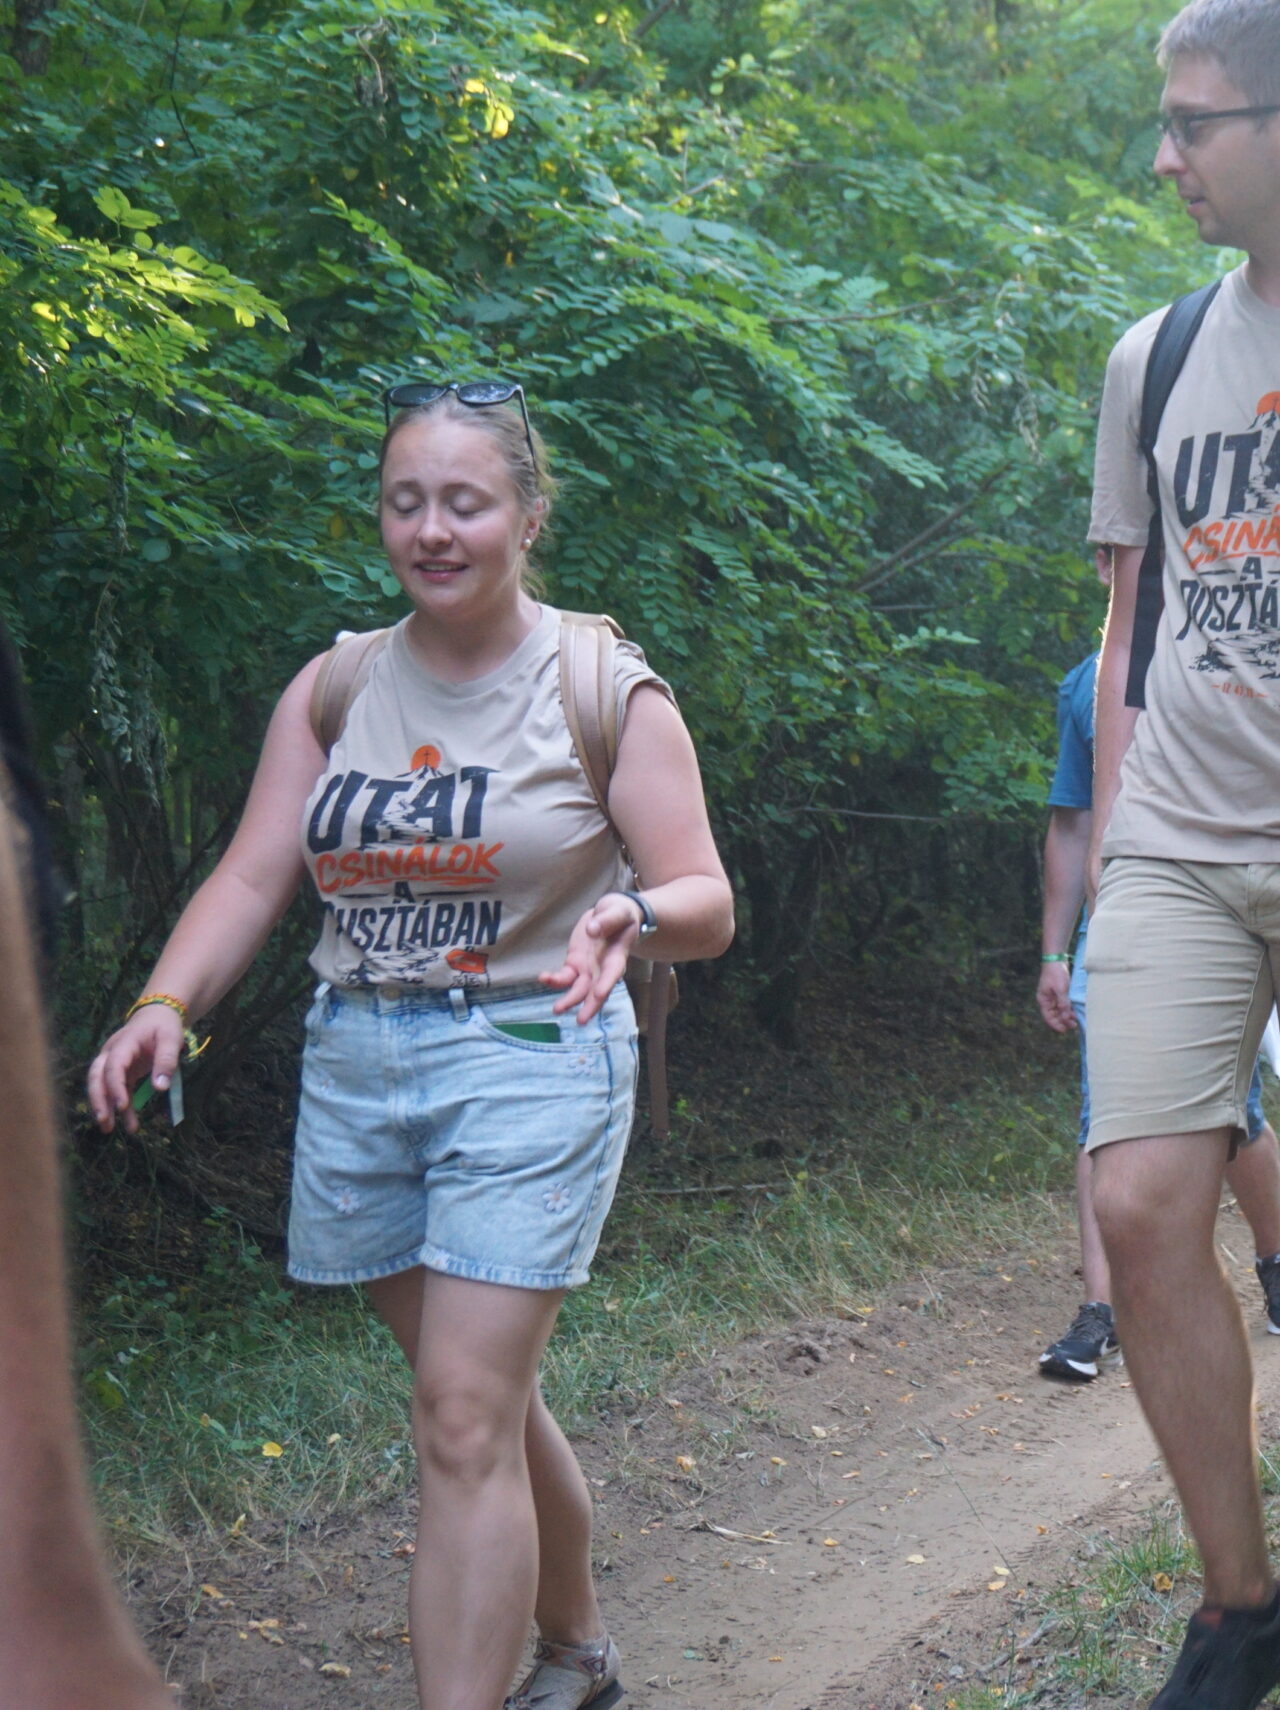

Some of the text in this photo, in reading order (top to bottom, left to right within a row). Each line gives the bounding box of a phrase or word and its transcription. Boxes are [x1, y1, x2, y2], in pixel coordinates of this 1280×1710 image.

[1239, 556, 1264, 581] A
[307, 766, 502, 854] UTAT
[314, 837, 505, 894] CSINÁLOK
[392, 881, 416, 904] A
[324, 899, 503, 952] USZTÁBAN
